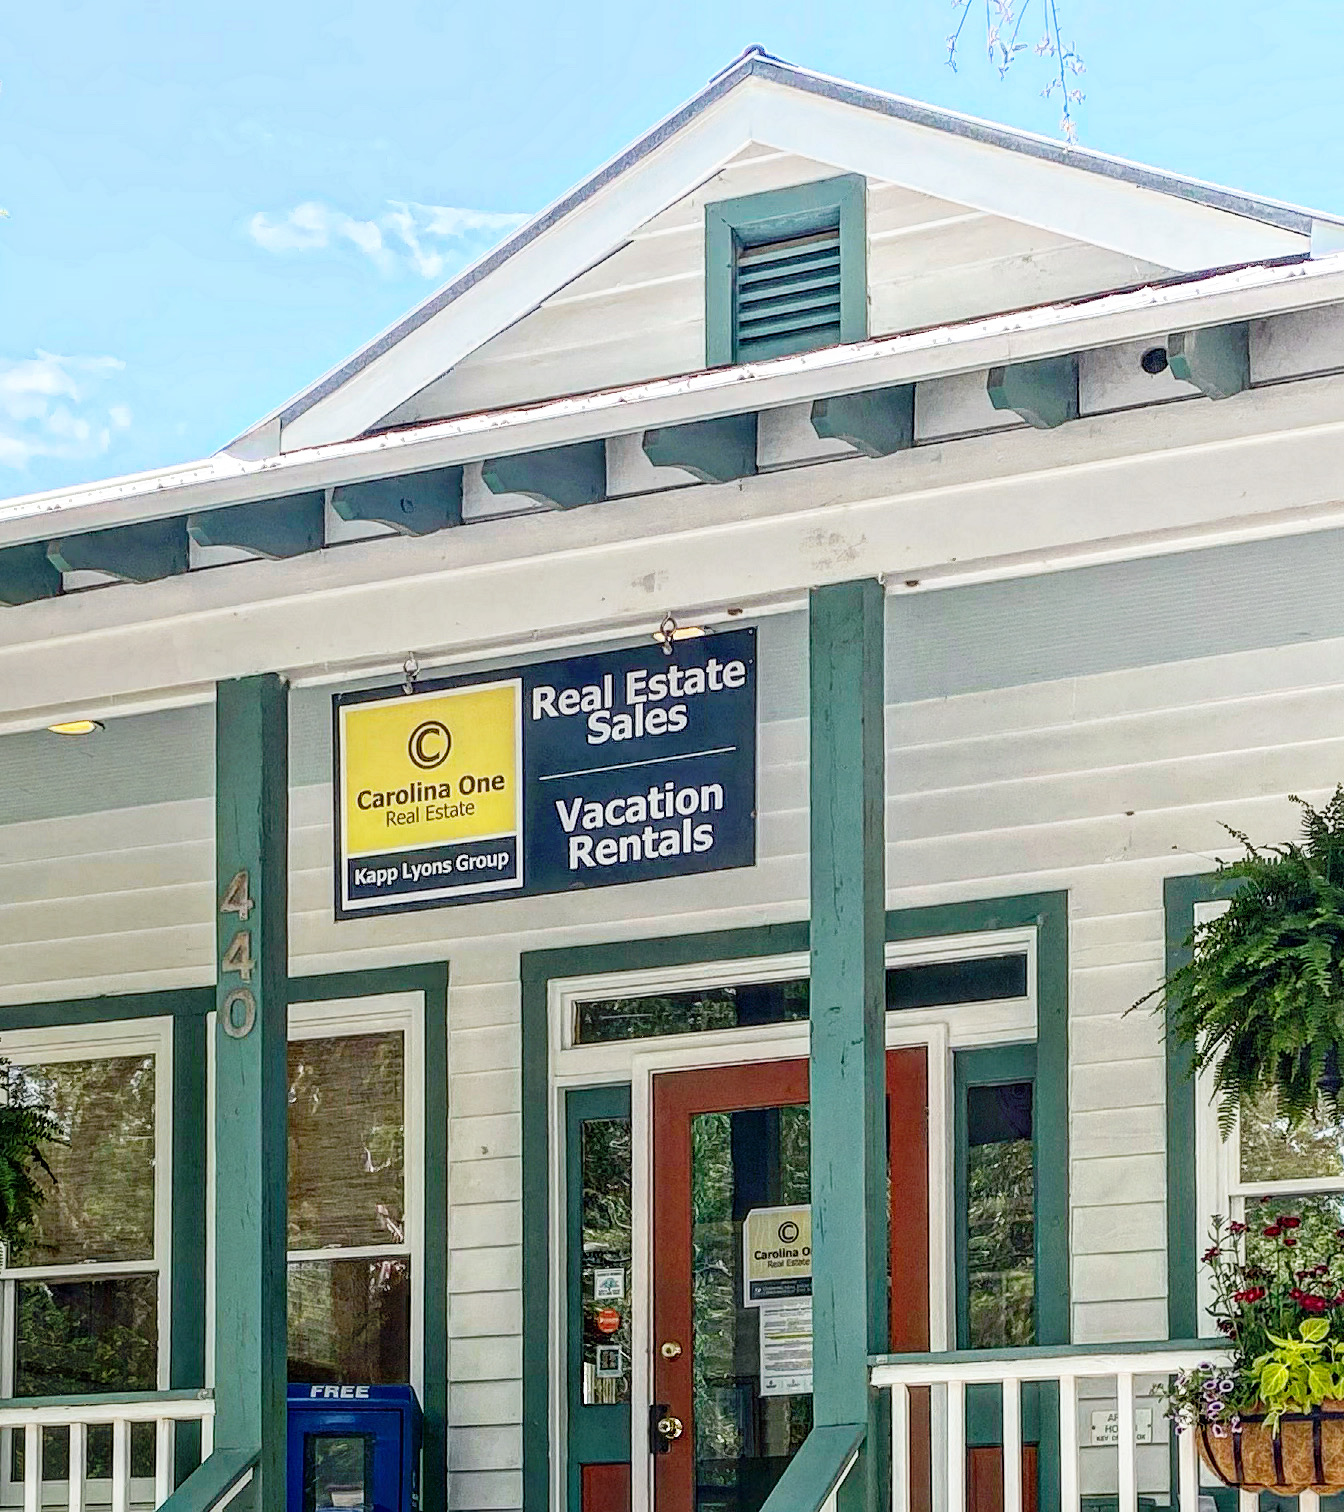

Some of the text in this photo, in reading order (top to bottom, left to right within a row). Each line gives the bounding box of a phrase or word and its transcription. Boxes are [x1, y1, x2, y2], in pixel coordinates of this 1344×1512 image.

[532, 657, 746, 720] Real Estate
[587, 702, 689, 745] Sales
[357, 774, 506, 811] Carolina One
[555, 781, 725, 833] Vacation
[386, 800, 476, 828] Real Estate
[568, 817, 715, 871] Rentals
[355, 852, 510, 886] Kapp Lyons Group
[220, 870, 256, 1039] 440
[754, 1248, 799, 1260] Carolina
[310, 1385, 371, 1399] FREE
